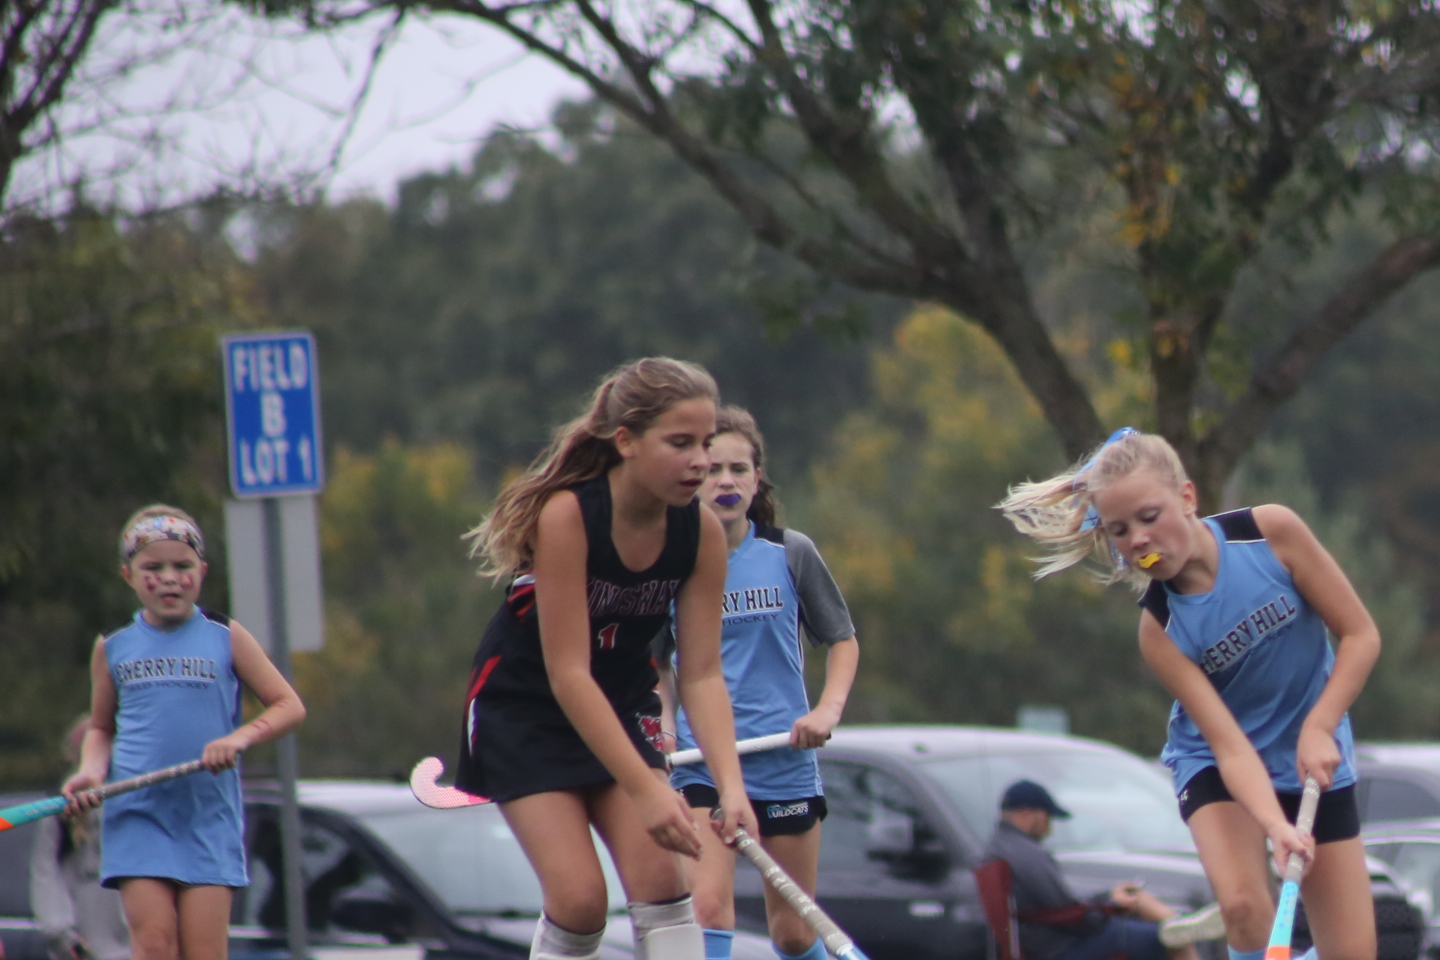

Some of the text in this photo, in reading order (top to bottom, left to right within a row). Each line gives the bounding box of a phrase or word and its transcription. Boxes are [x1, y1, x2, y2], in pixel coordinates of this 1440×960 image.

[233, 343, 308, 392] FIELD
[261, 391, 287, 438] B
[239, 436, 313, 486] LOT 1
[744, 586, 784, 611] HILL
[597, 622, 620, 650] 1
[722, 613, 778, 627] HOCKEY
[1199, 618, 1254, 675] HERRY
[1248, 594, 1297, 636] HILL
[115, 656, 217, 682] CHERRY HILL
